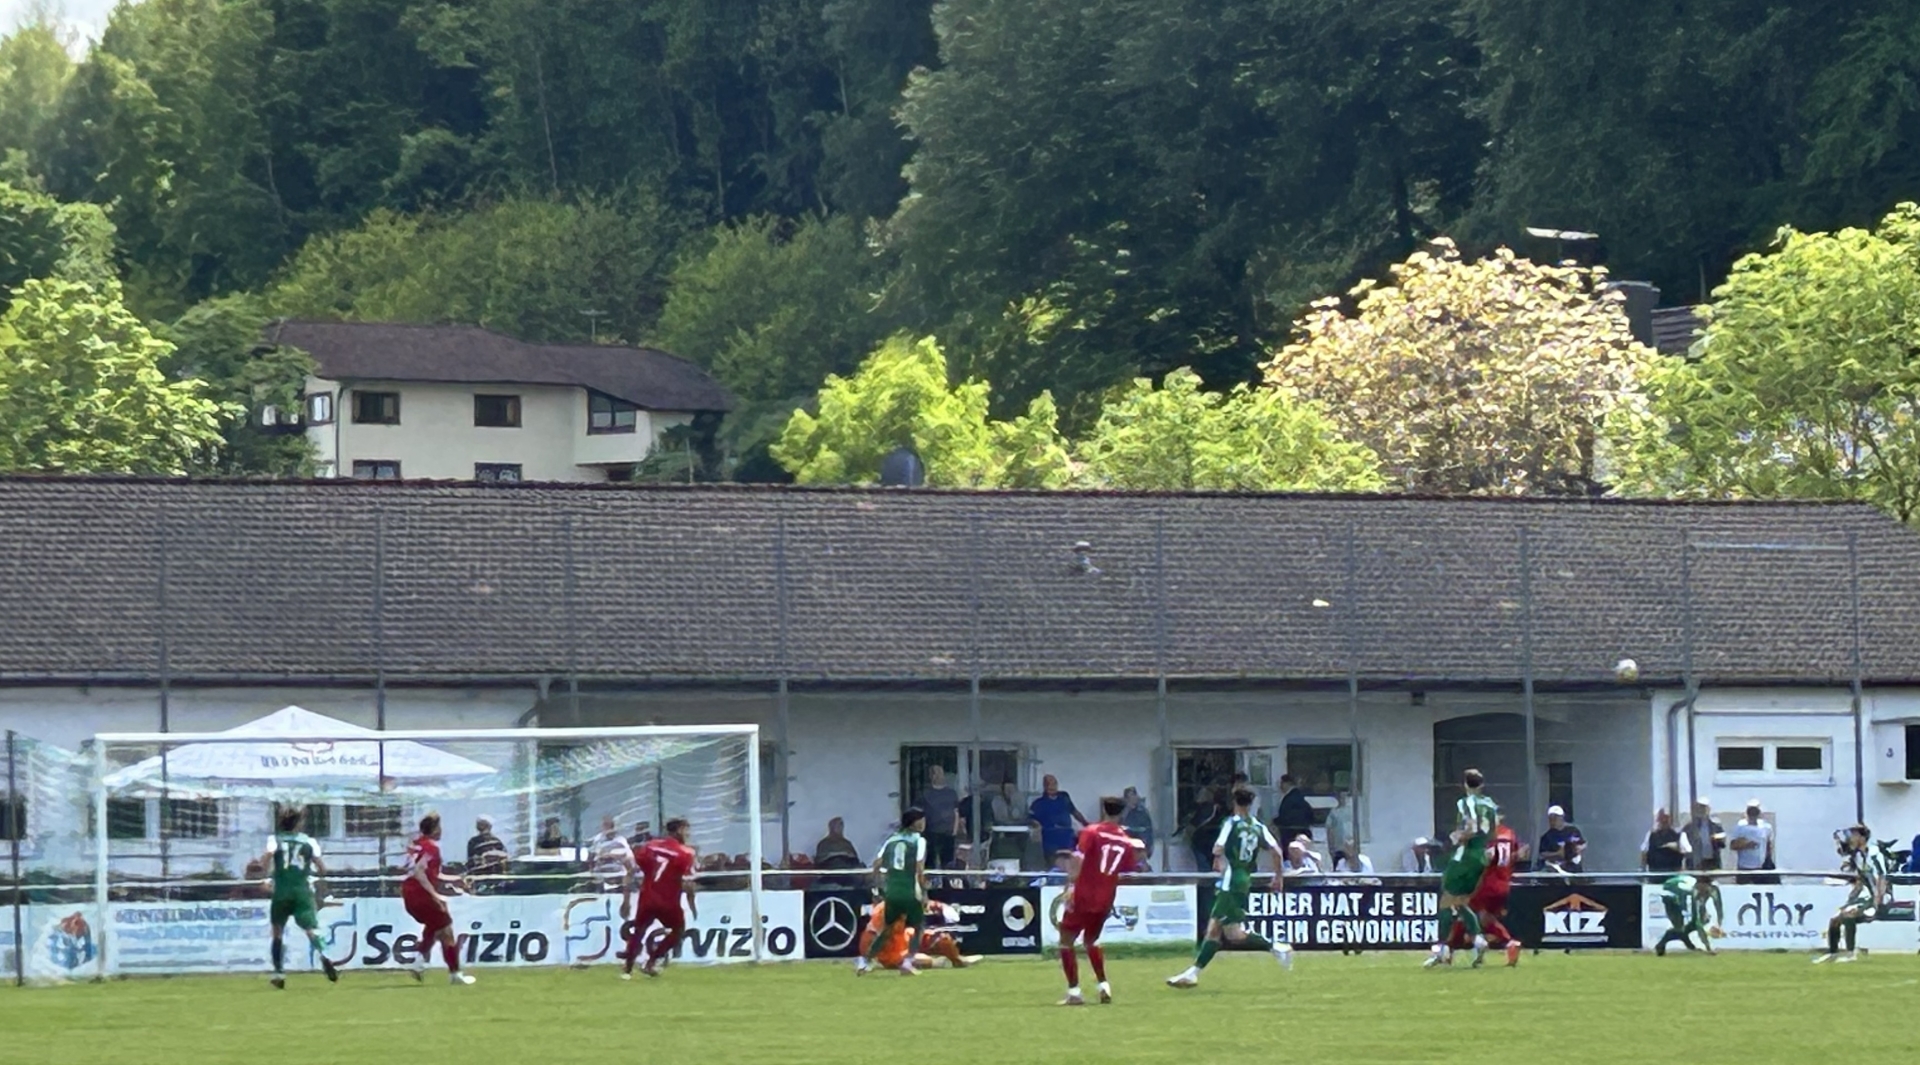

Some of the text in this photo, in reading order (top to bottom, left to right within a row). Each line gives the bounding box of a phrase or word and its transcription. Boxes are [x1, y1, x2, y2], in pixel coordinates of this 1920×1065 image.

[656, 856, 669, 882] 7
[1101, 844, 1125, 875] 17
[1320, 892, 1363, 917] HAT
[1368, 892, 1394, 917] JE
[1402, 892, 1438, 916] EIN
[1737, 892, 1813, 926] dhr
[362, 920, 549, 965] Seizio
[1315, 919, 1439, 944] GEWONNEN
